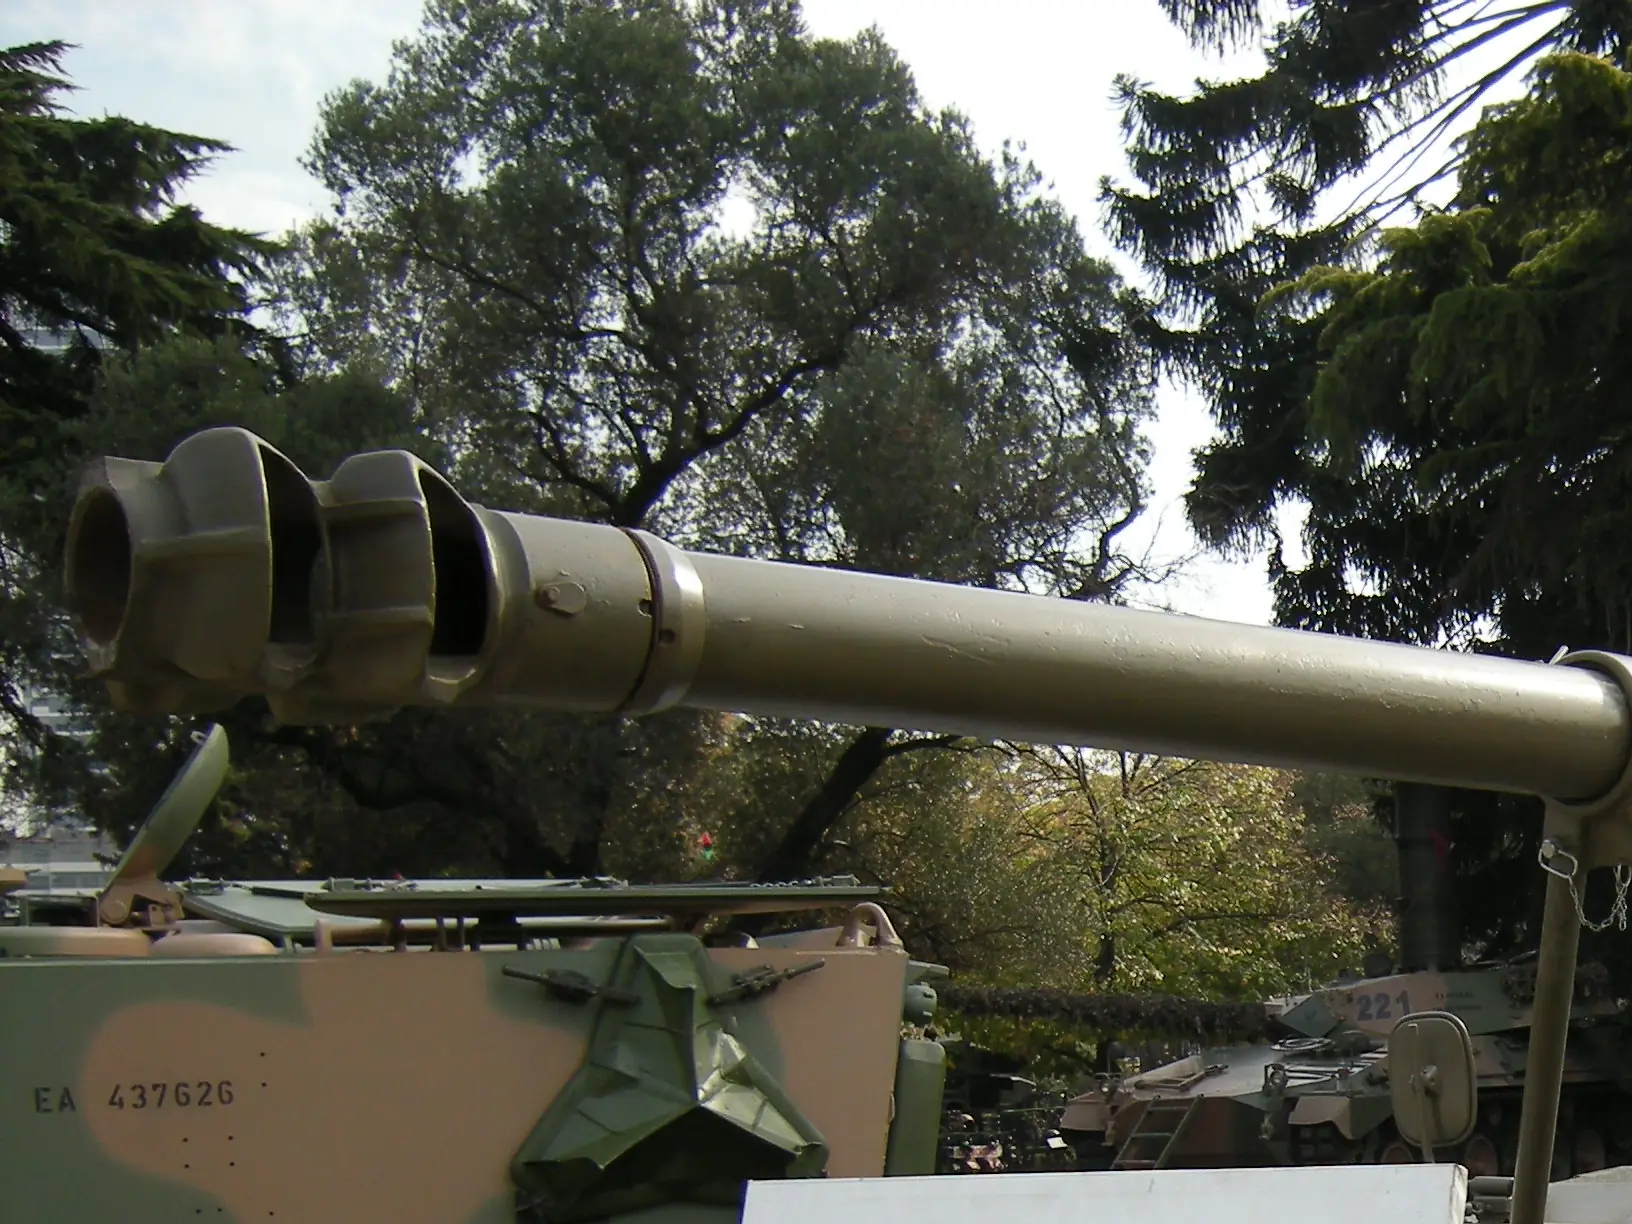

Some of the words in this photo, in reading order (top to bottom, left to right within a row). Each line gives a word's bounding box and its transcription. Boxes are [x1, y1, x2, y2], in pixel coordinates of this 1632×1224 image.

[1355, 990, 1411, 1021] 221
[34, 1087, 77, 1113] EA
[108, 1080, 234, 1110] 437626
